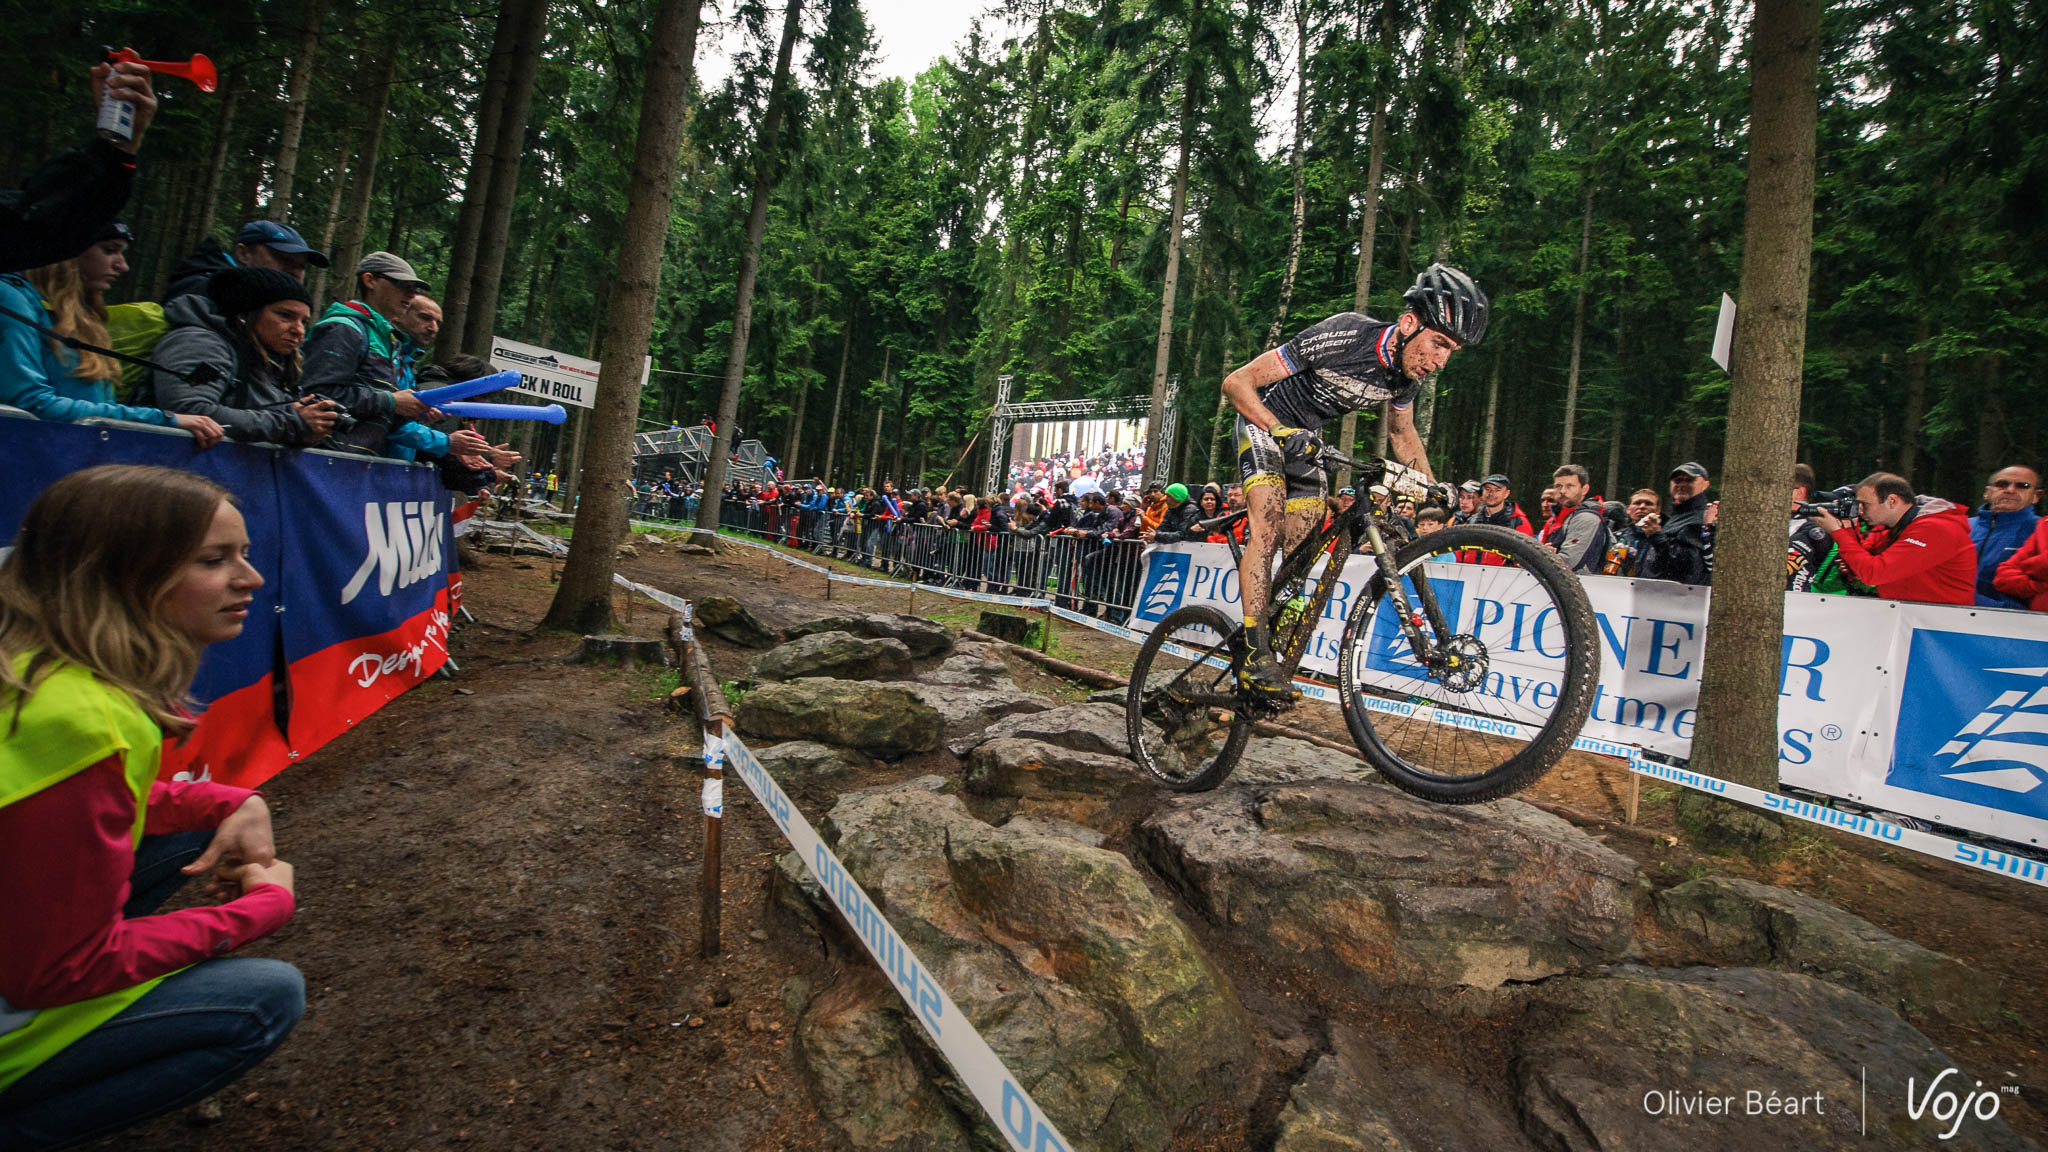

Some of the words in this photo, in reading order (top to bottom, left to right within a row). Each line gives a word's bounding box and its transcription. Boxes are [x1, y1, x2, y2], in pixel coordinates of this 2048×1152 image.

[539, 379, 550, 395] N
[552, 382, 582, 402] ROLL
[1351, 595, 1369, 621] COBRA
[1096, 620, 1131, 638] SHIMANO
[1434, 711, 1518, 736] SHIMANO
[1763, 793, 1903, 841] SHIMANO
